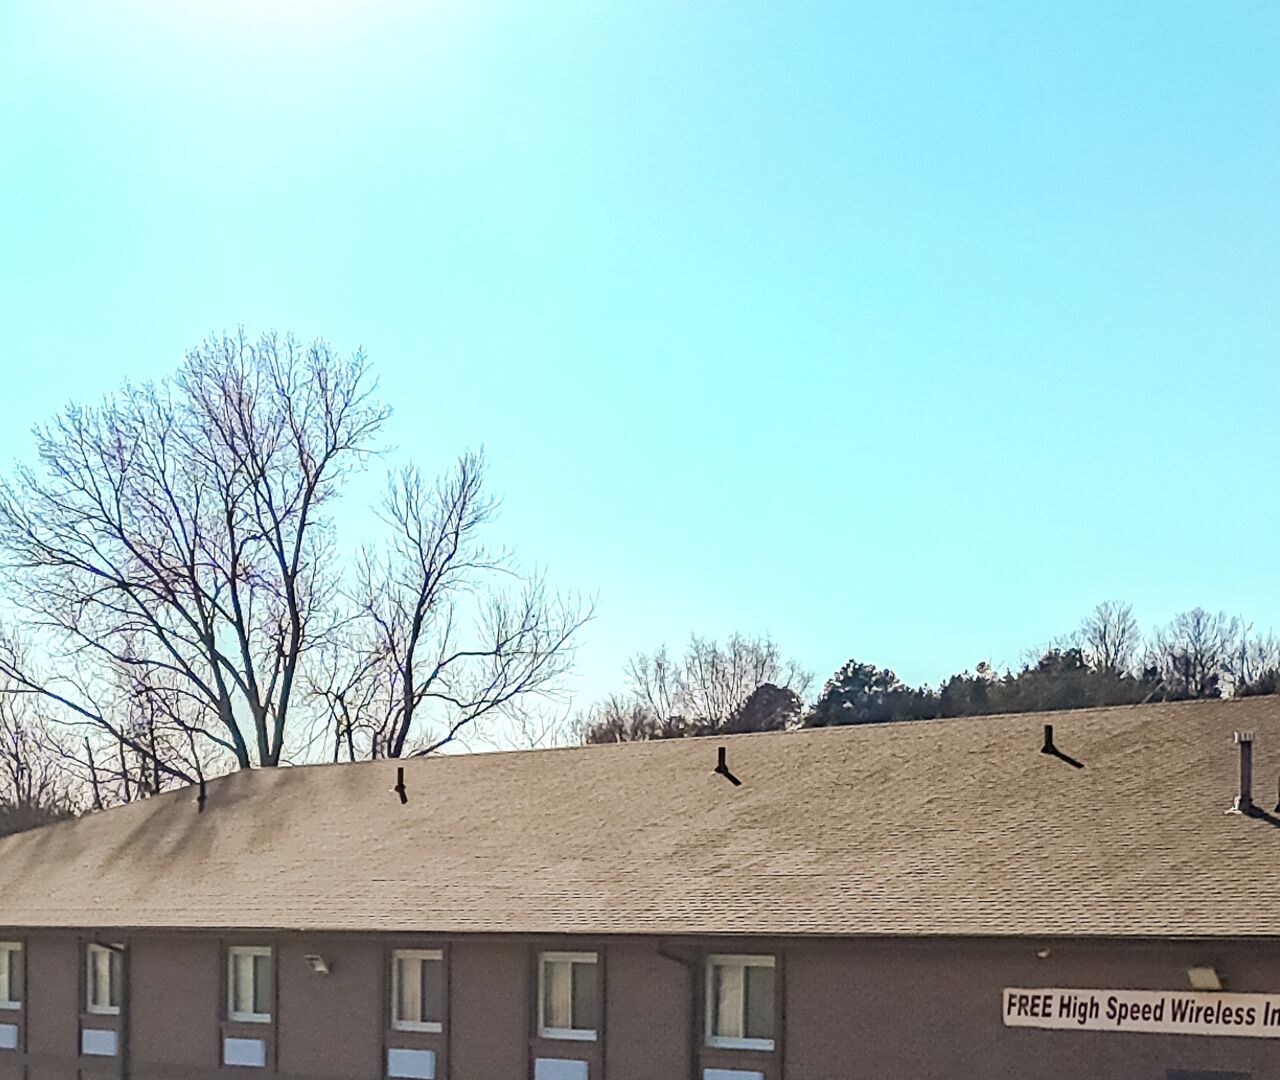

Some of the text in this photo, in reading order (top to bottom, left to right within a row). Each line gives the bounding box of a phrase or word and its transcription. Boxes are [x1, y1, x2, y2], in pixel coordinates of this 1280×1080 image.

[1006, 993, 1053, 1018] FREE
[1058, 995, 1100, 1025] High
[1105, 996, 1164, 1026] Speed
[1170, 998, 1256, 1026] Wireless
